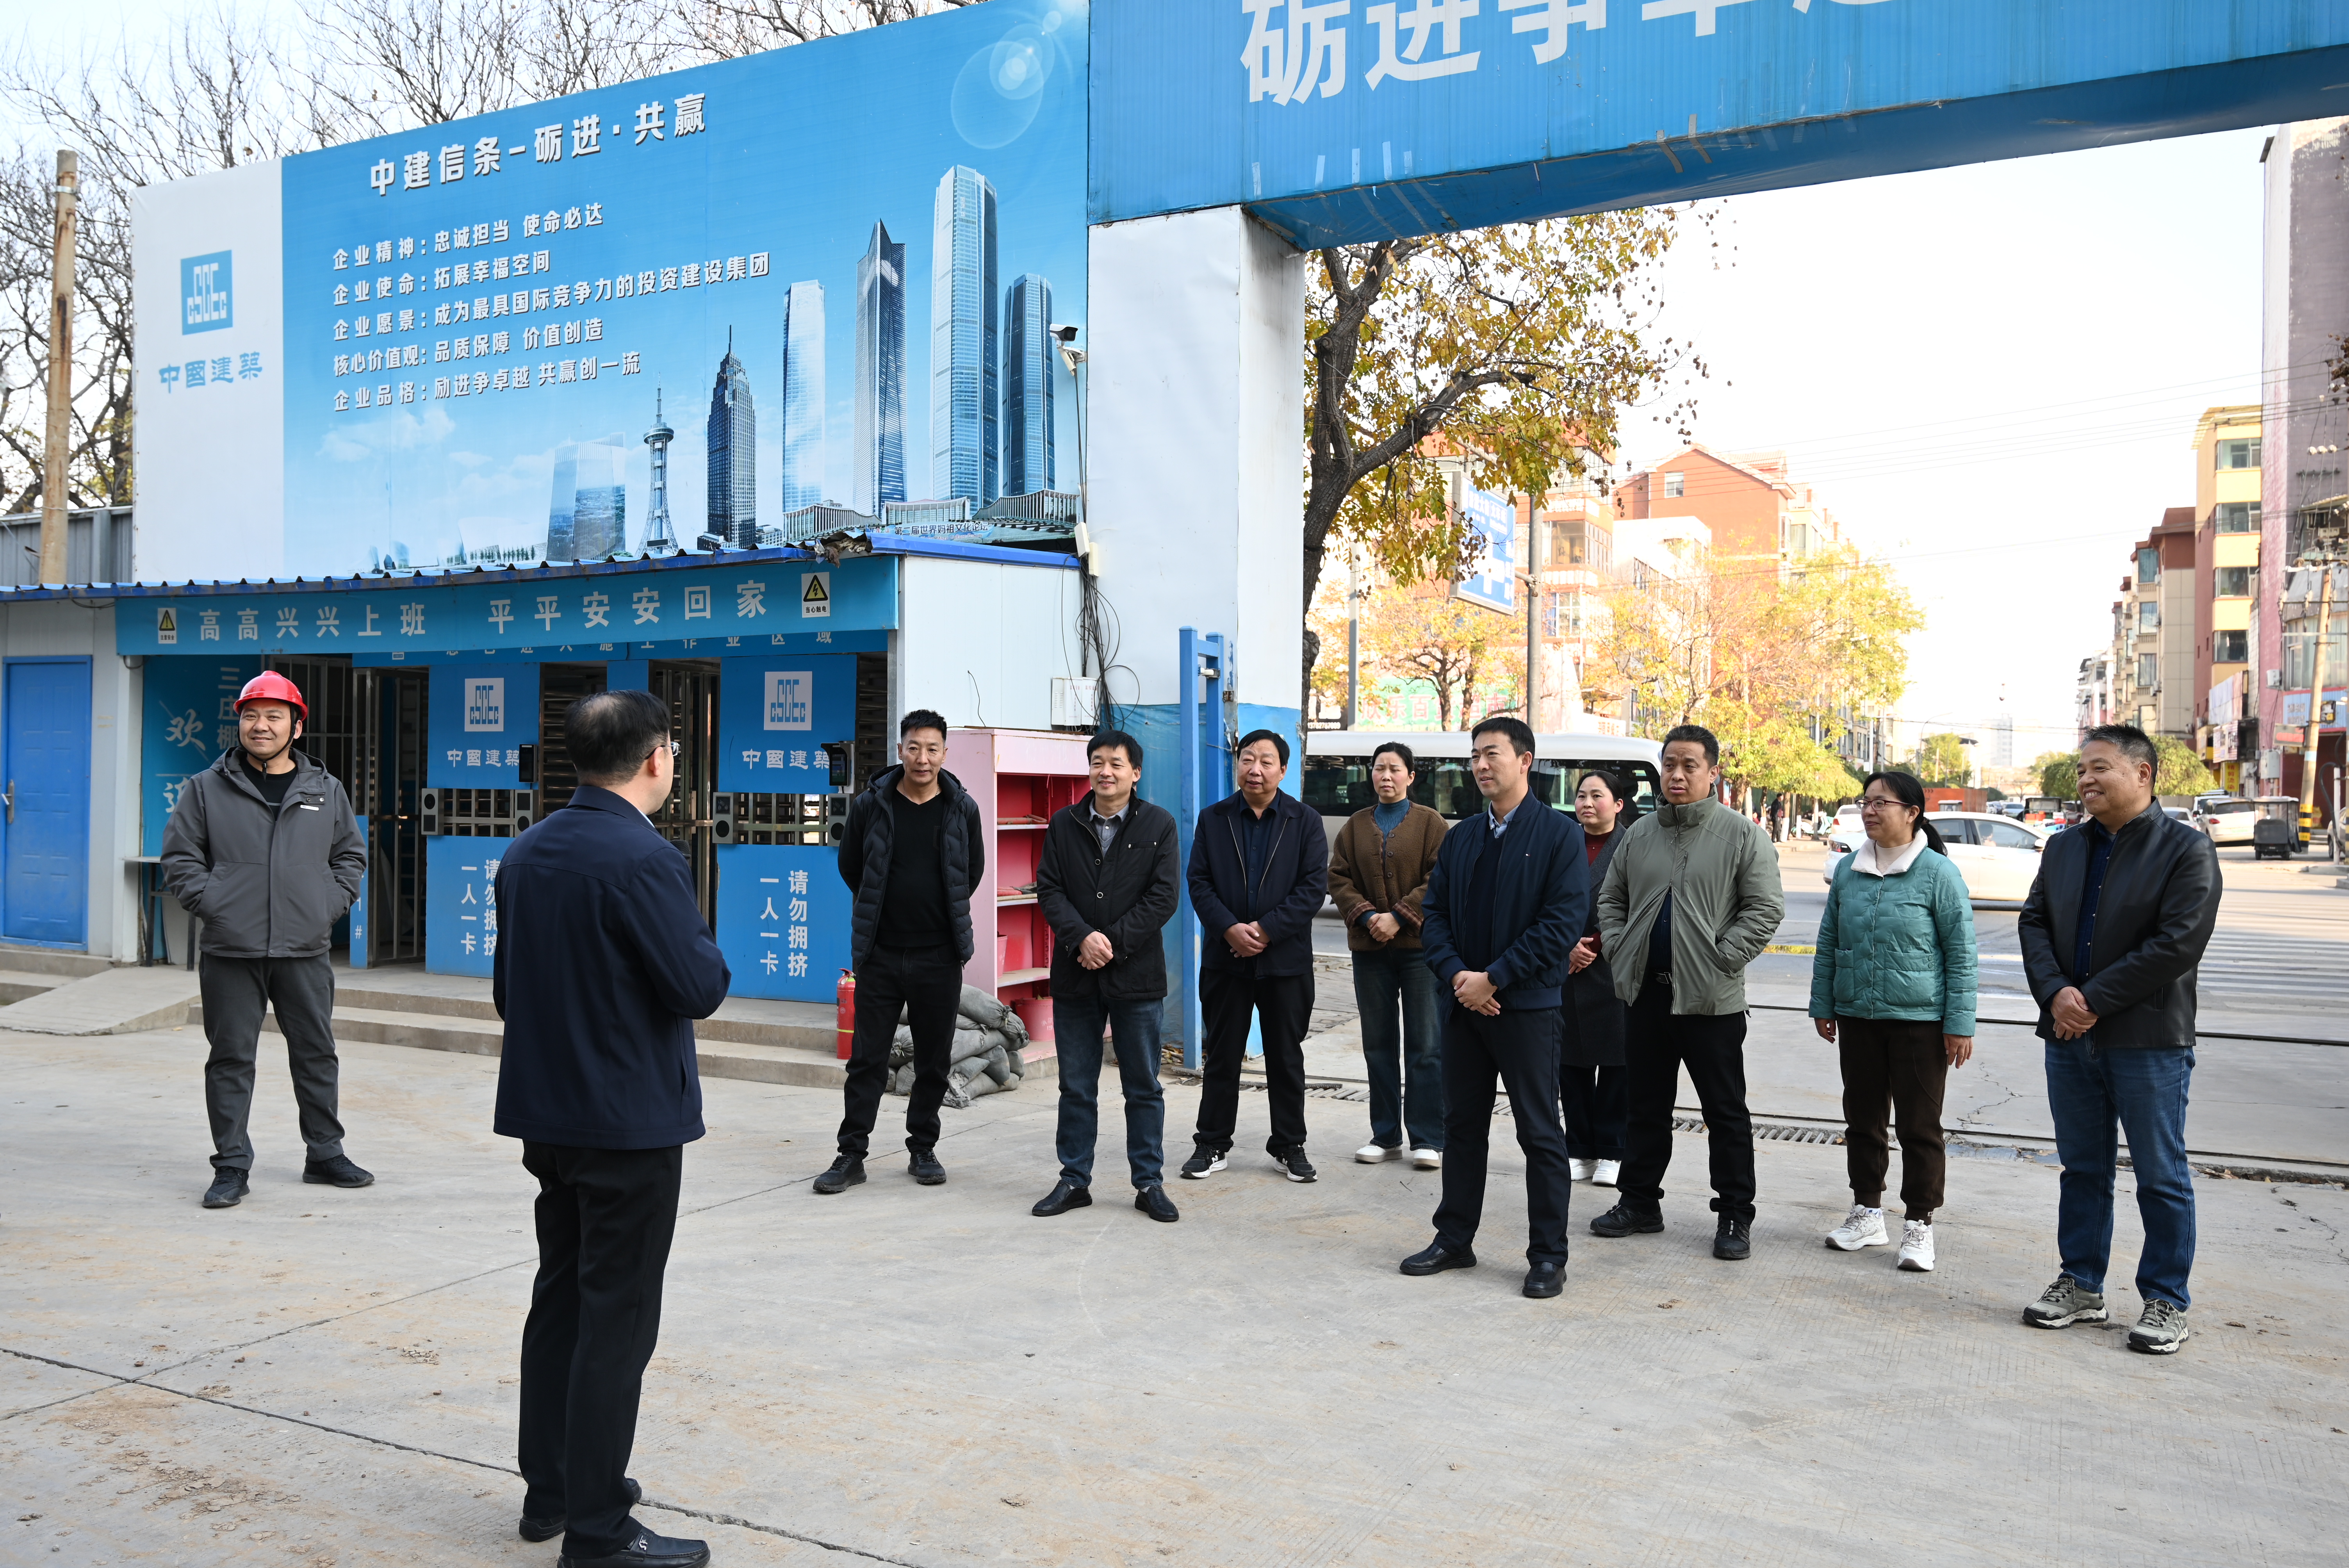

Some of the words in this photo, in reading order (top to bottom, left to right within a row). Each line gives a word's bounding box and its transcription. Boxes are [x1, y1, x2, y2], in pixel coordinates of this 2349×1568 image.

[523, 203, 602, 237] 使命必达
[523, 317, 602, 350] 价值创造
[538, 351, 640, 386] 共赢创一流
[894, 522, 988, 535] 第二届世界妈祖文化论坛
[200, 603, 425, 641] 高高兴兴上班
[488, 580, 767, 634] 平平安安回家
[461, 866, 477, 955] 一人一卡
[760, 877, 779, 975] 一人一卡
[788, 870, 808, 977] 请勿拥挤
